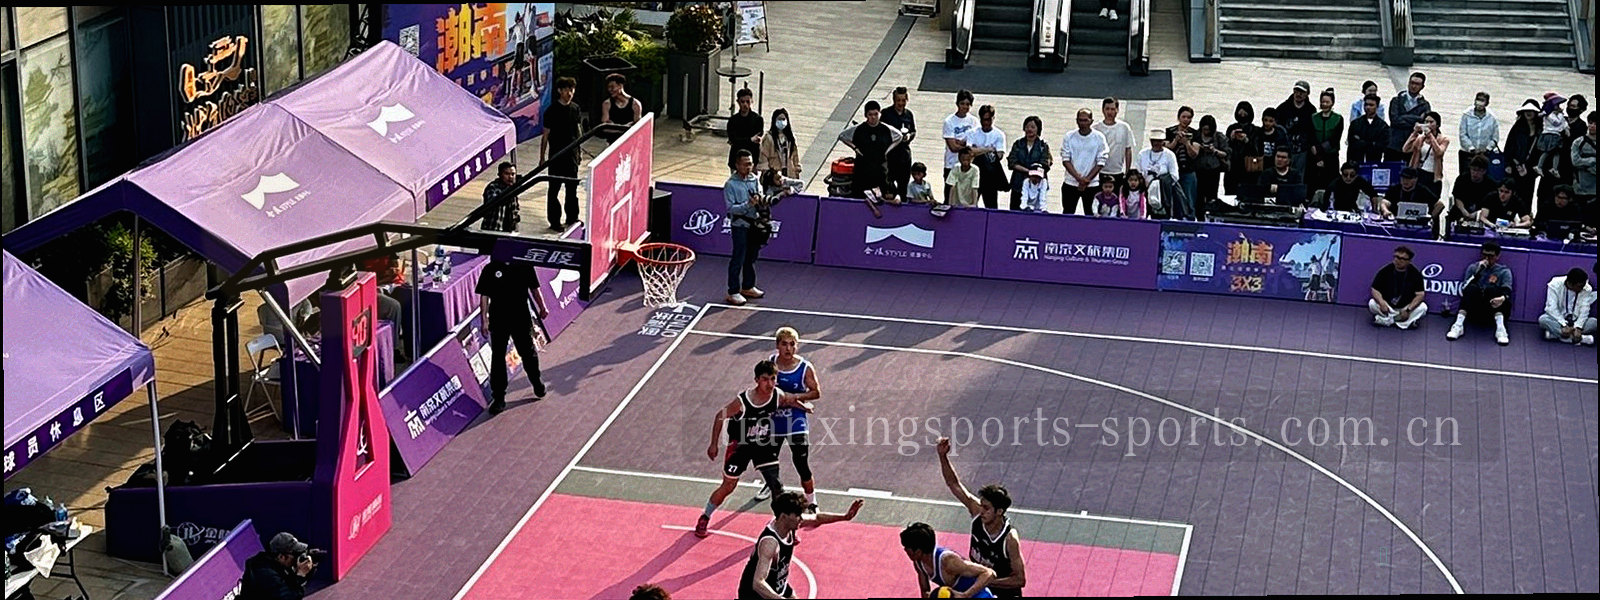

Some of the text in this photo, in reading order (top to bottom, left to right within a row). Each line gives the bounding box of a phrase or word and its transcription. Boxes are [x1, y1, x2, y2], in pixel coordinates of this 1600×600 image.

[1044, 242, 1130, 260] 南京文旅集团
[4, 391, 105, 473] 球员休息区
[728, 464, 738, 473] 27
